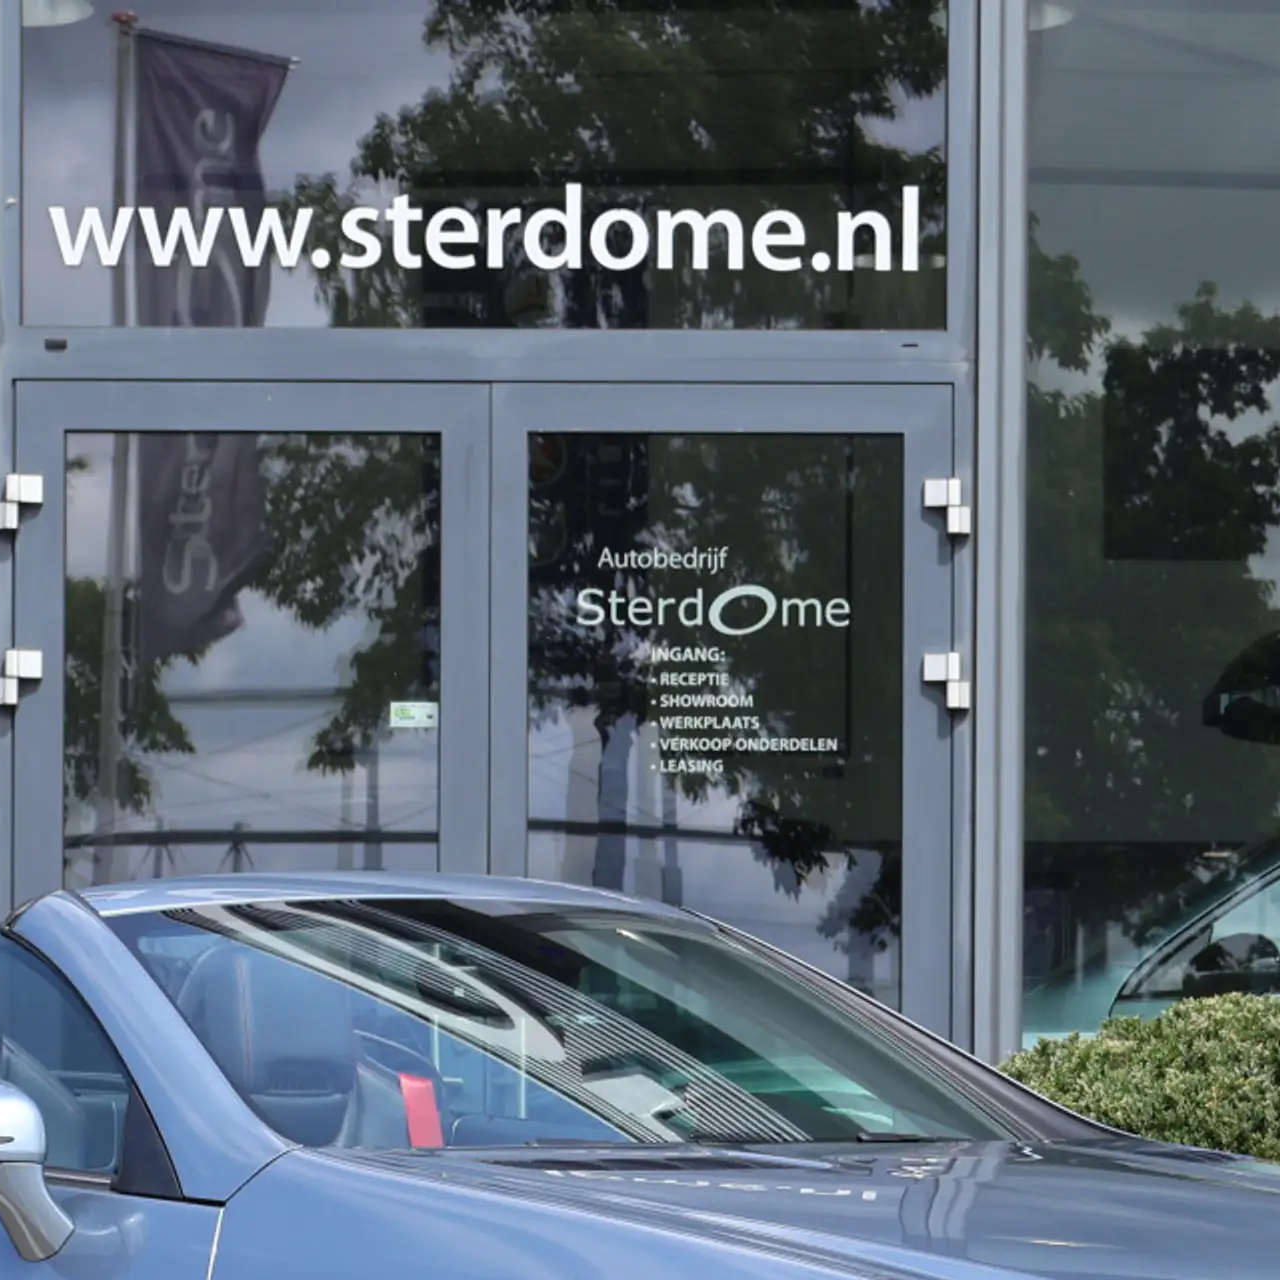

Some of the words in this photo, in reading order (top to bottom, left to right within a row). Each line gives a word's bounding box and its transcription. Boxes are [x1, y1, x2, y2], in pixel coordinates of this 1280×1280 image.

[47, 182, 920, 271] www.sterdome.nl
[597, 545, 729, 575] Autobedrijf
[575, 584, 852, 636] SterdOme
[651, 646, 726, 662] INGANG:
[659, 671, 730, 686] RECEPTIE
[659, 693, 754, 709] SHOWROOM
[659, 716, 760, 730] WERKPLAATS
[659, 738, 732, 752] VERKOOP
[734, 738, 838, 752] ONDERDELEN
[659, 759, 724, 774] LEASING
